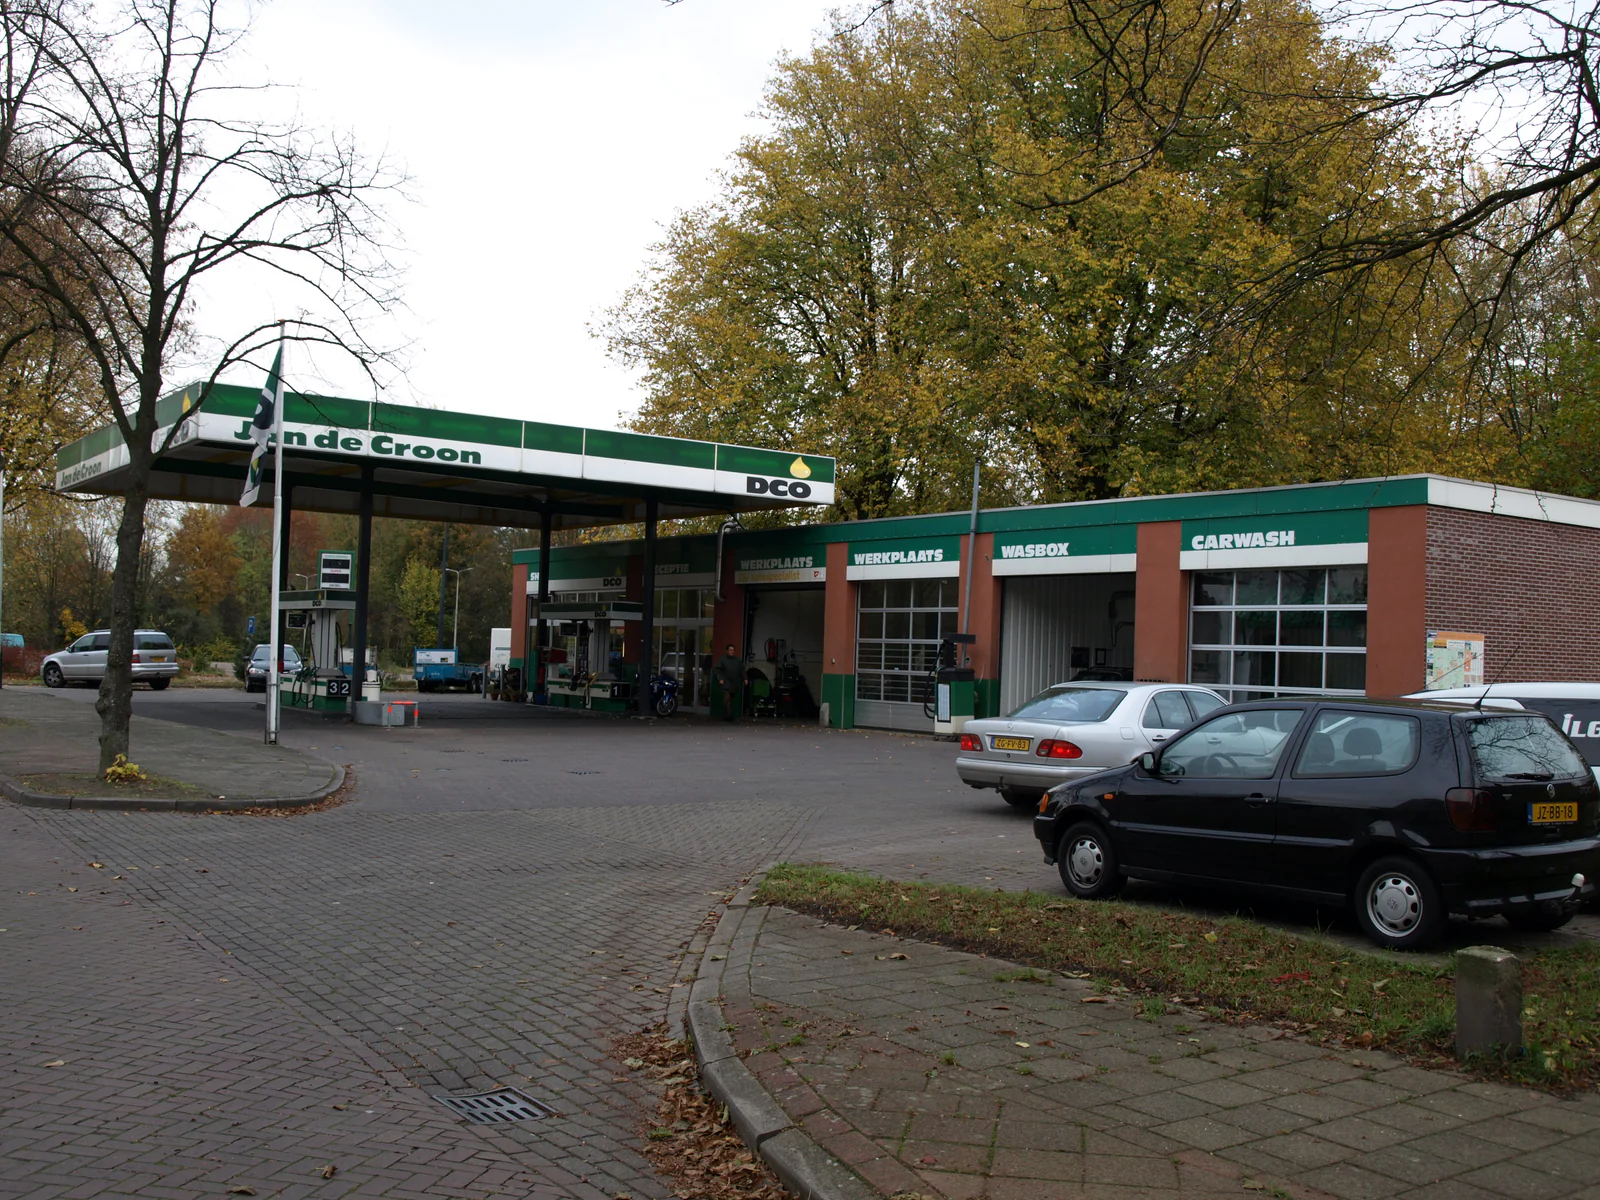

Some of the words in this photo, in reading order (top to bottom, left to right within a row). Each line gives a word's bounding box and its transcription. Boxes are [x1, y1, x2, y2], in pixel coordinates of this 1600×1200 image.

[234, 421, 306, 446] Jn
[314, 431, 363, 451] de
[371, 436, 482, 465] Croon
[746, 476, 812, 499] DCO
[1191, 530, 1296, 550] CARWASH
[854, 549, 944, 565] WERKPLAATS
[1001, 542, 1069, 559] WASBOX
[654, 563, 690, 574] ECEPTIE
[740, 556, 813, 570] WERKPLAATS
[602, 577, 622, 587] DCO
[612, 685, 618, 696] 1
[996, 739, 1026, 749] ZG-FV-83
[1537, 805, 1573, 820] JZ-BB-18
